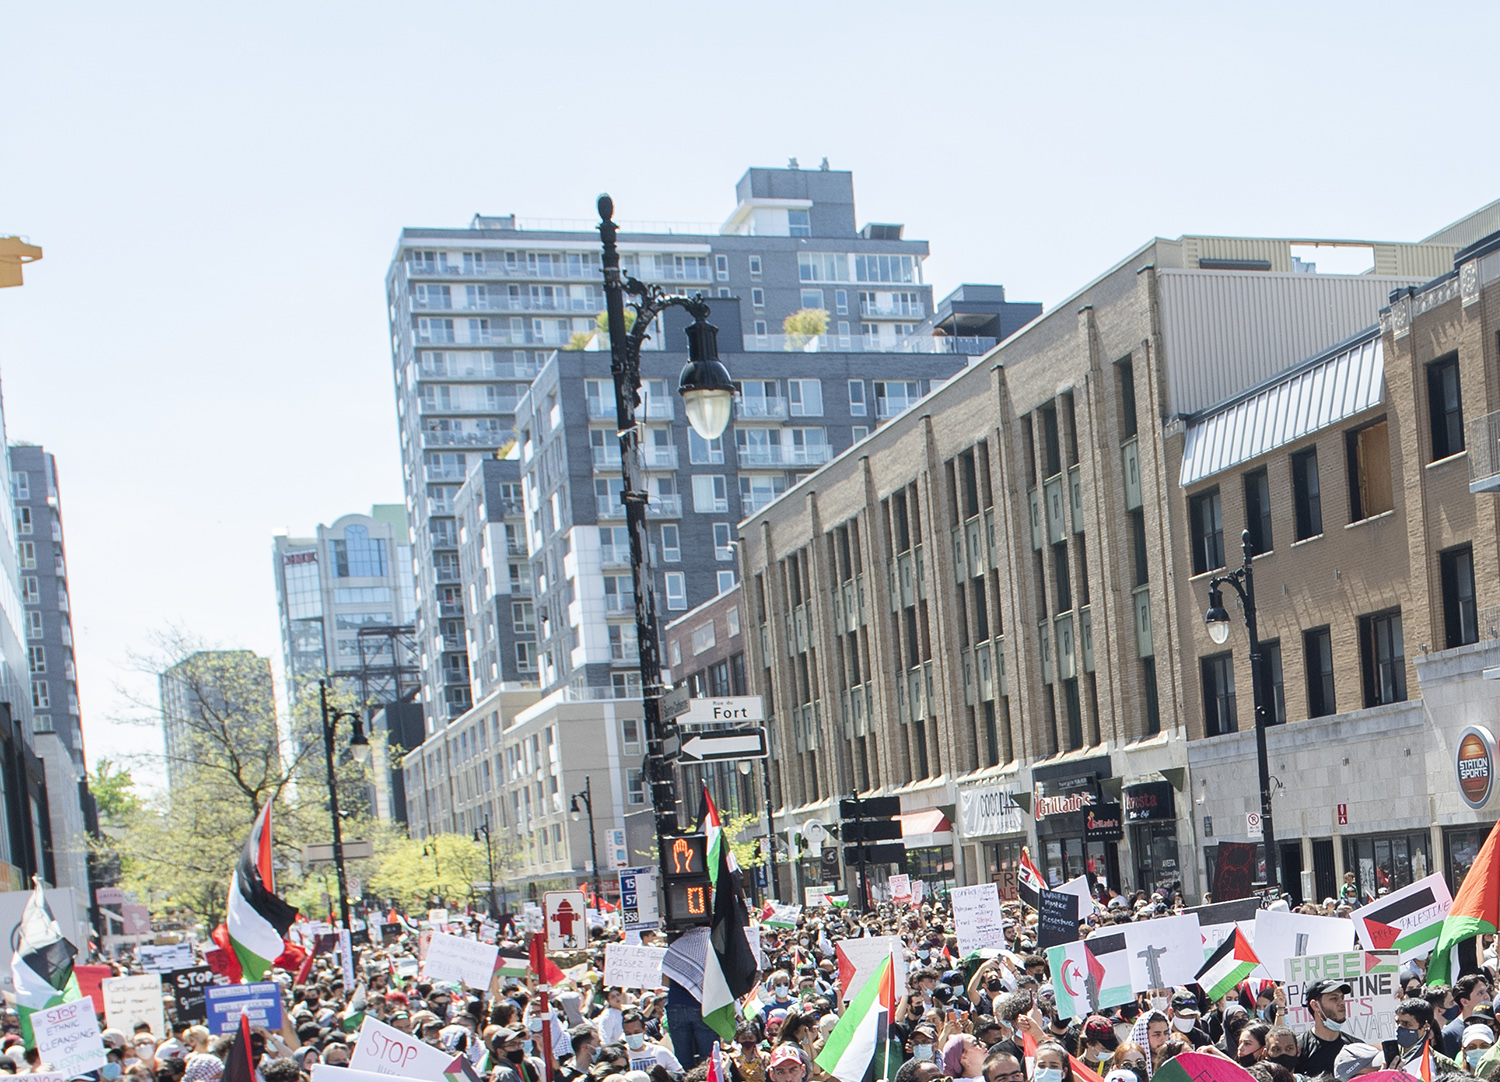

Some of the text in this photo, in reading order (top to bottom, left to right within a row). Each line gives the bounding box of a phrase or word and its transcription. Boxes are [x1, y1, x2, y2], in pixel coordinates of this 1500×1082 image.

[713, 707, 748, 719] Fort
[1459, 757, 1488, 770] STATION
[1460, 768, 1488, 780] SPORTS
[1039, 791, 1092, 815] Grillado's
[626, 879, 636, 889] 15
[626, 894, 637, 905] 57
[687, 887, 705, 914] 0
[1042, 890, 1069, 902] WHEN
[624, 912, 638, 923] 358
[1372, 899, 1451, 941] FREE PALESTINE
[1290, 952, 1361, 982] FREE
[176, 970, 214, 988] STOP
[1287, 973, 1392, 1008] PATINE
[46, 1004, 77, 1023] STOP
[46, 1019, 81, 1037] ETHNIC
[39, 1028, 96, 1053] CLEANSING
[64, 1042, 78, 1054] OF
[366, 1030, 418, 1068] STOP
